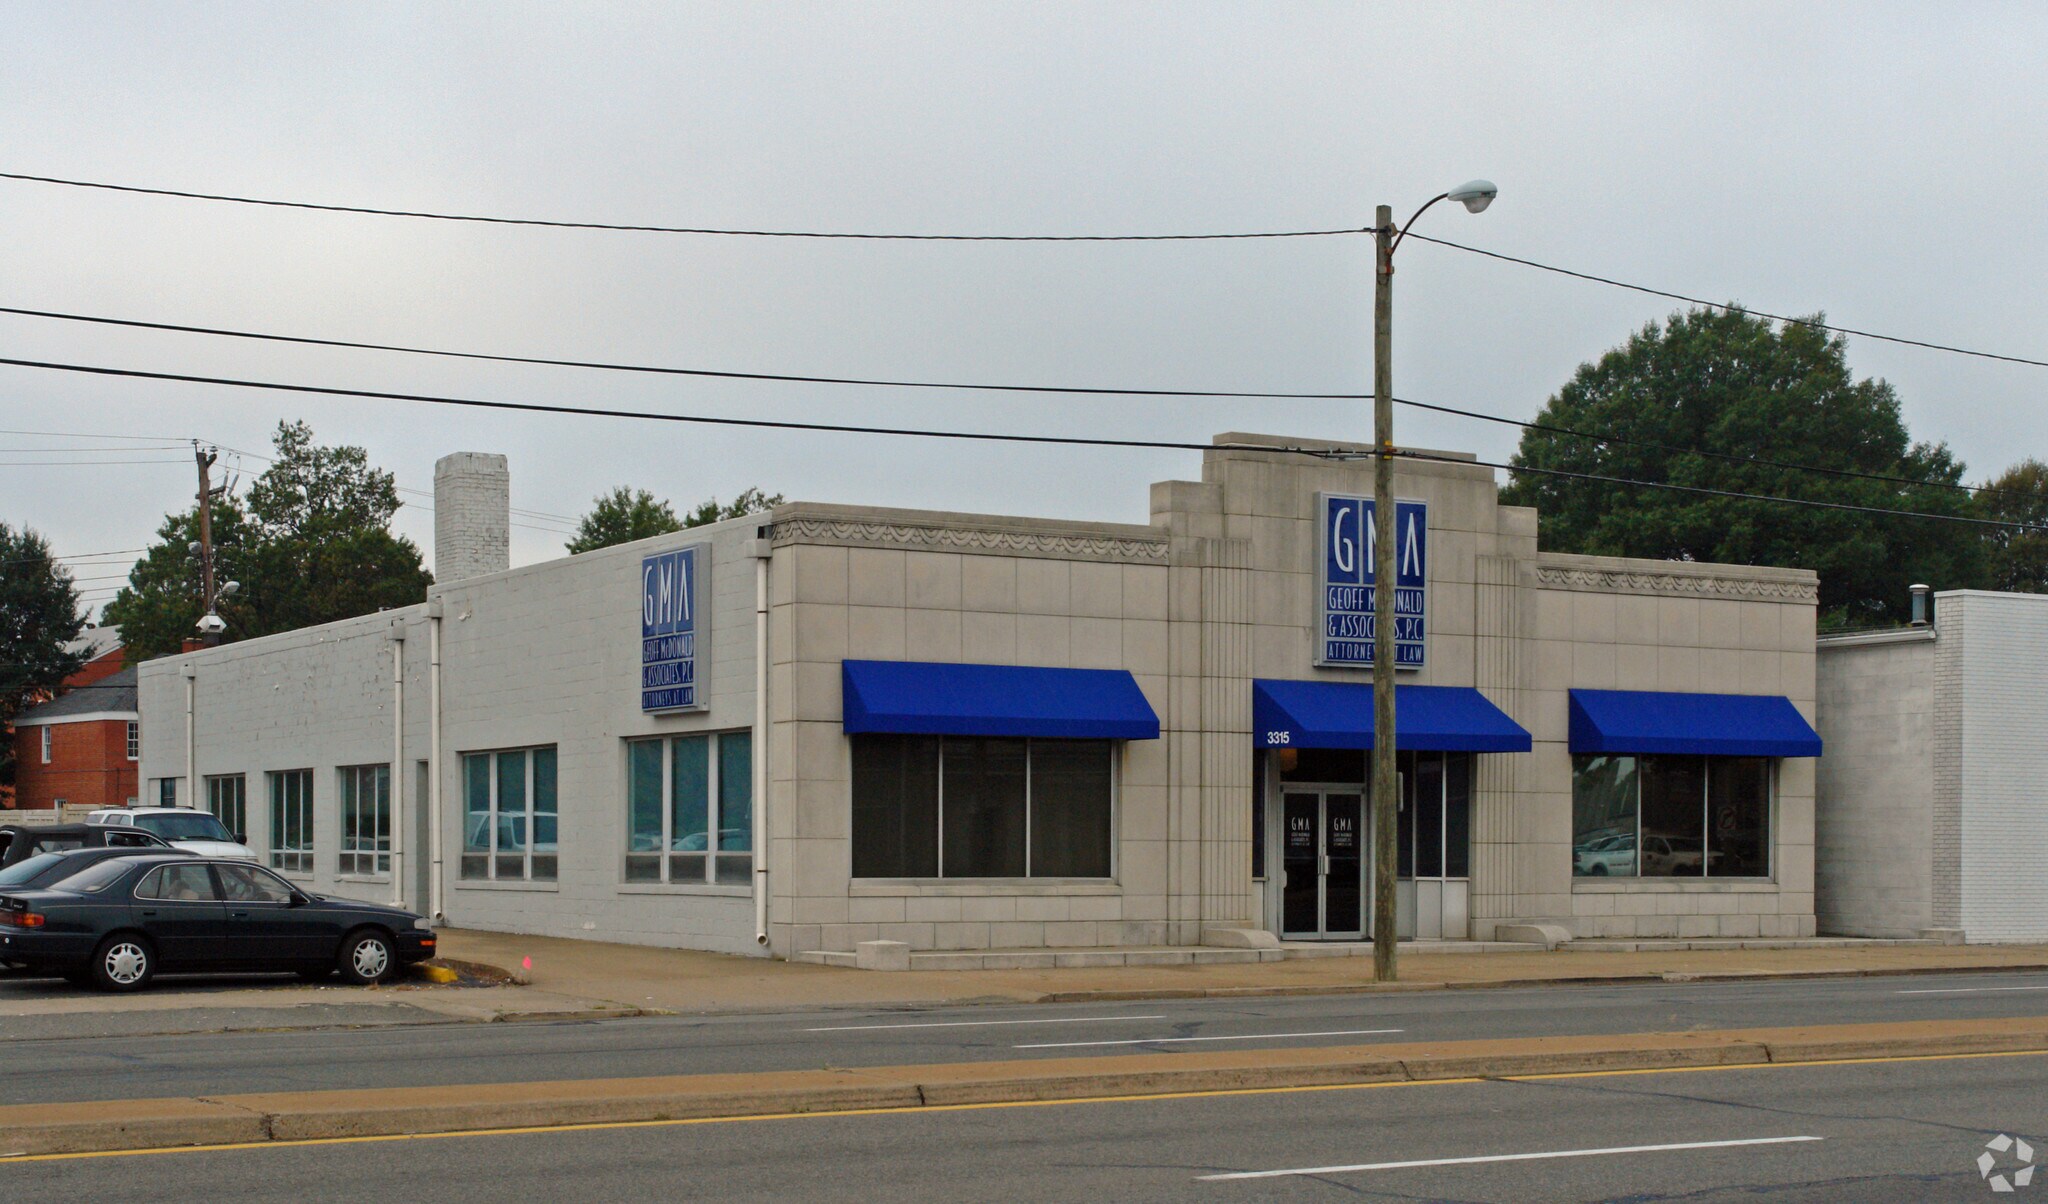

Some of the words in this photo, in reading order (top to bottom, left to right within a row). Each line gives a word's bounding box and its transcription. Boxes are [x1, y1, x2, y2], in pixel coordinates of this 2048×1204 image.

[643, 559, 690, 626] GMA
[1328, 587, 1364, 610] GEOFF
[1368, 588, 1423, 613] MNALD
[1328, 614, 1337, 637] &
[1405, 618, 1423, 640] P.C.
[643, 640, 660, 662] GEOFF
[1328, 642, 1375, 660] ATTORNE
[1403, 645, 1423, 661] LAW
[673, 689, 680, 704] AT
[681, 688, 693, 704] LAW
[1267, 731, 1290, 744] 3315
[1291, 816, 1310, 831] GMA
[1333, 817, 1352, 831] GMA
